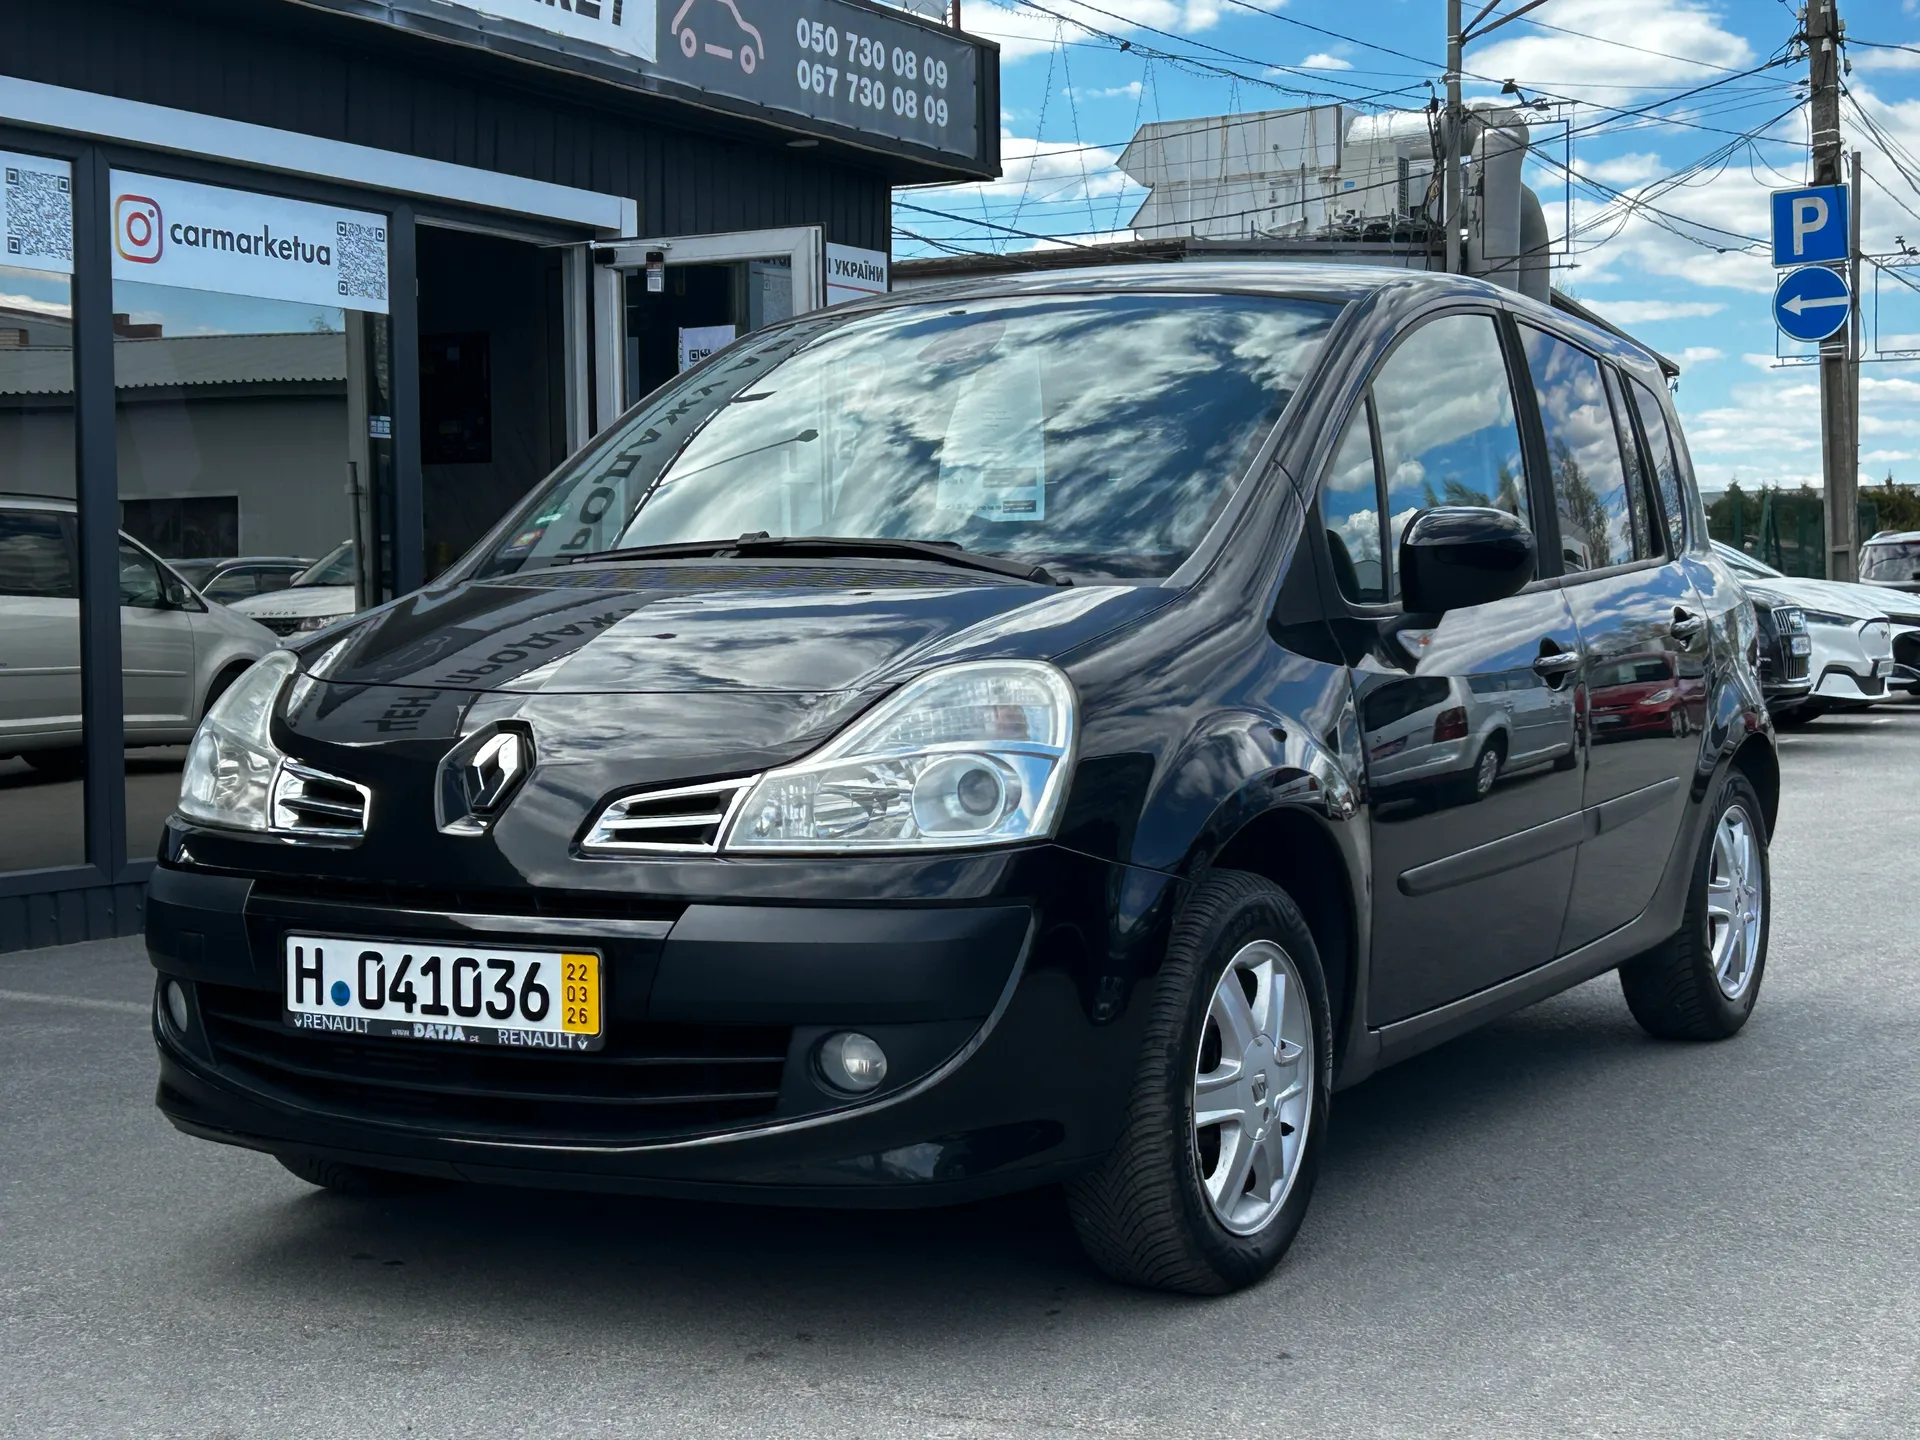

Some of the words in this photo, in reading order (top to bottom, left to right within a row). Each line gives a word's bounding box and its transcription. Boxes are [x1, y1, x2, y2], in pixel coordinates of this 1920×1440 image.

[796, 17, 838, 57] 050
[845, 31, 885, 71] 730
[892, 46, 918, 80] 08
[923, 55, 948, 90] 09
[796, 59, 839, 98] 067
[846, 72, 886, 110] 730
[892, 86, 918, 119] 08
[923, 95, 949, 128] 09
[170, 223, 331, 266] carmarketua
[1792, 196, 1829, 256] P
[834, 257, 884, 283] УКРАЇНИ
[294, 945, 324, 1006] H
[357, 950, 550, 1022] 041036
[566, 963, 588, 981] 22
[567, 985, 588, 1003] 03
[303, 1013, 371, 1034] RENAULT
[413, 1022, 466, 1041] DATJA
[498, 1029, 576, 1048] RENAULT
[567, 1007, 588, 1025] 26
